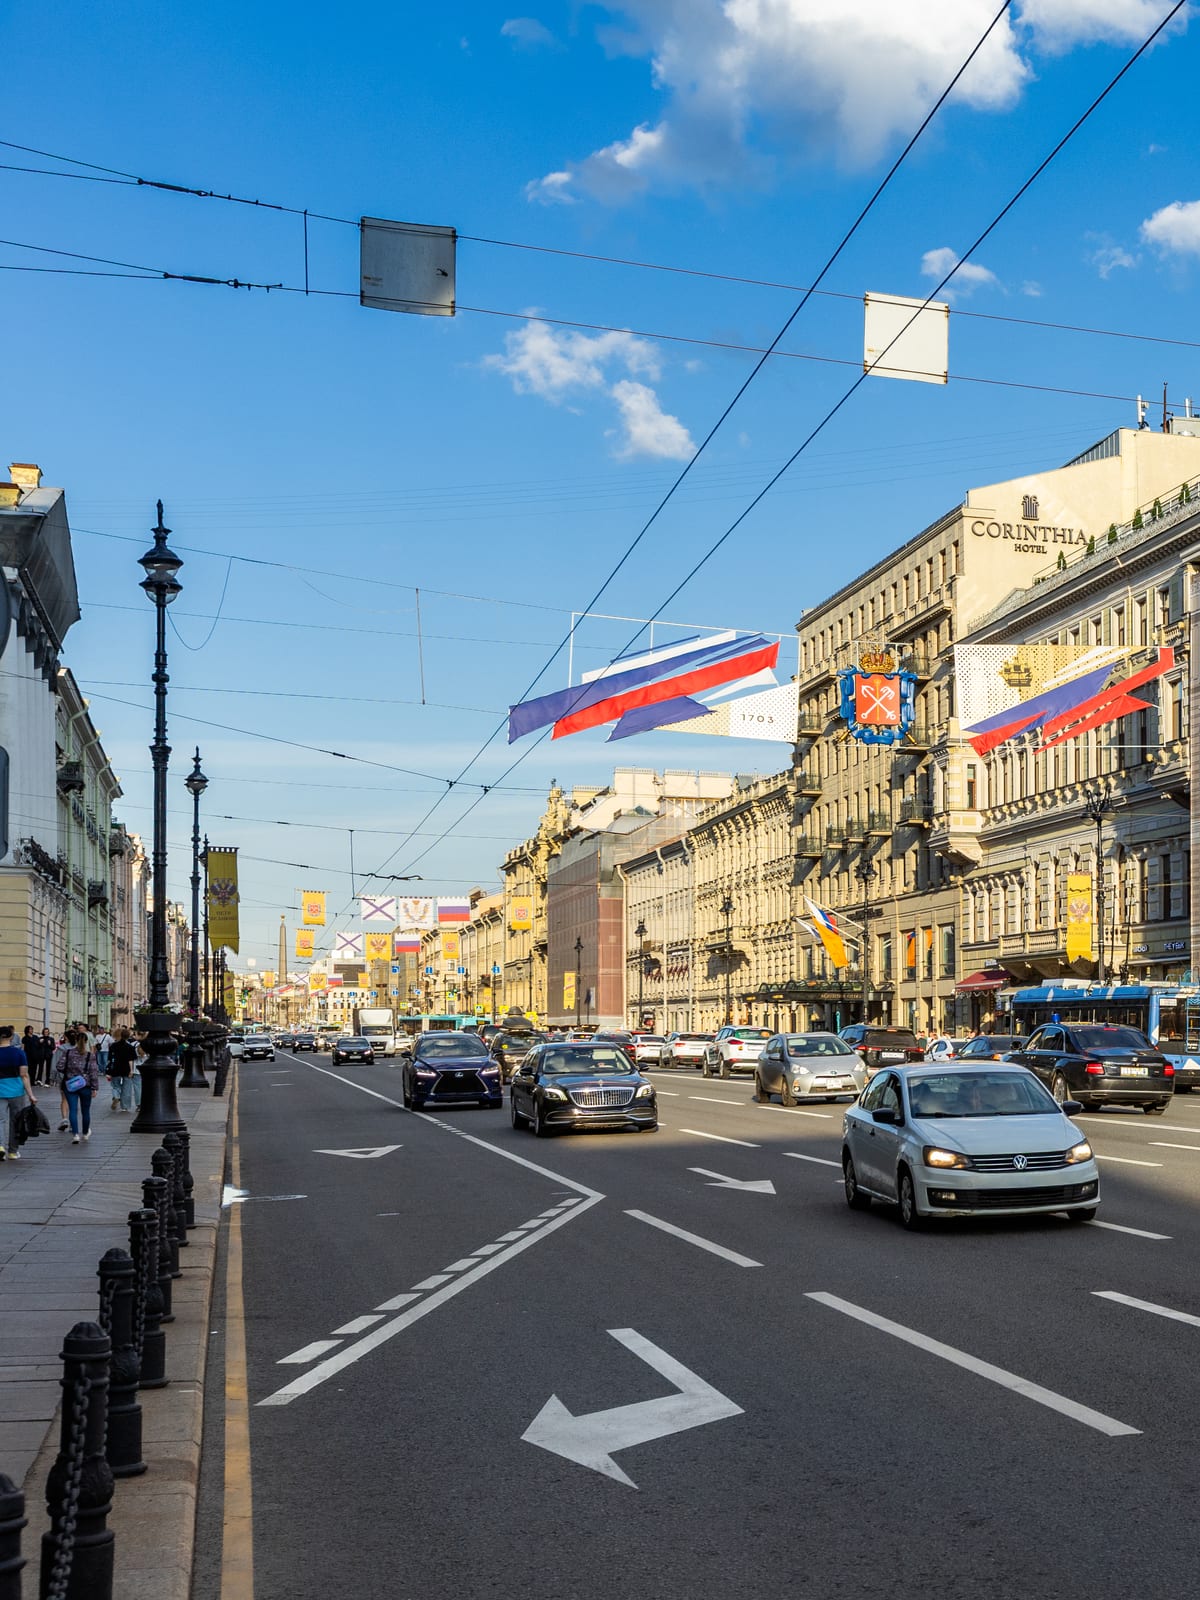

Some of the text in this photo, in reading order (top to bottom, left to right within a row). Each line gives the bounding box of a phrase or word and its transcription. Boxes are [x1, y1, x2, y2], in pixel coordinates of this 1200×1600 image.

[971, 521, 1088, 545] CORINTHIA
[1014, 544, 1047, 554] HOTEL
[741, 714, 774, 723] 1703
